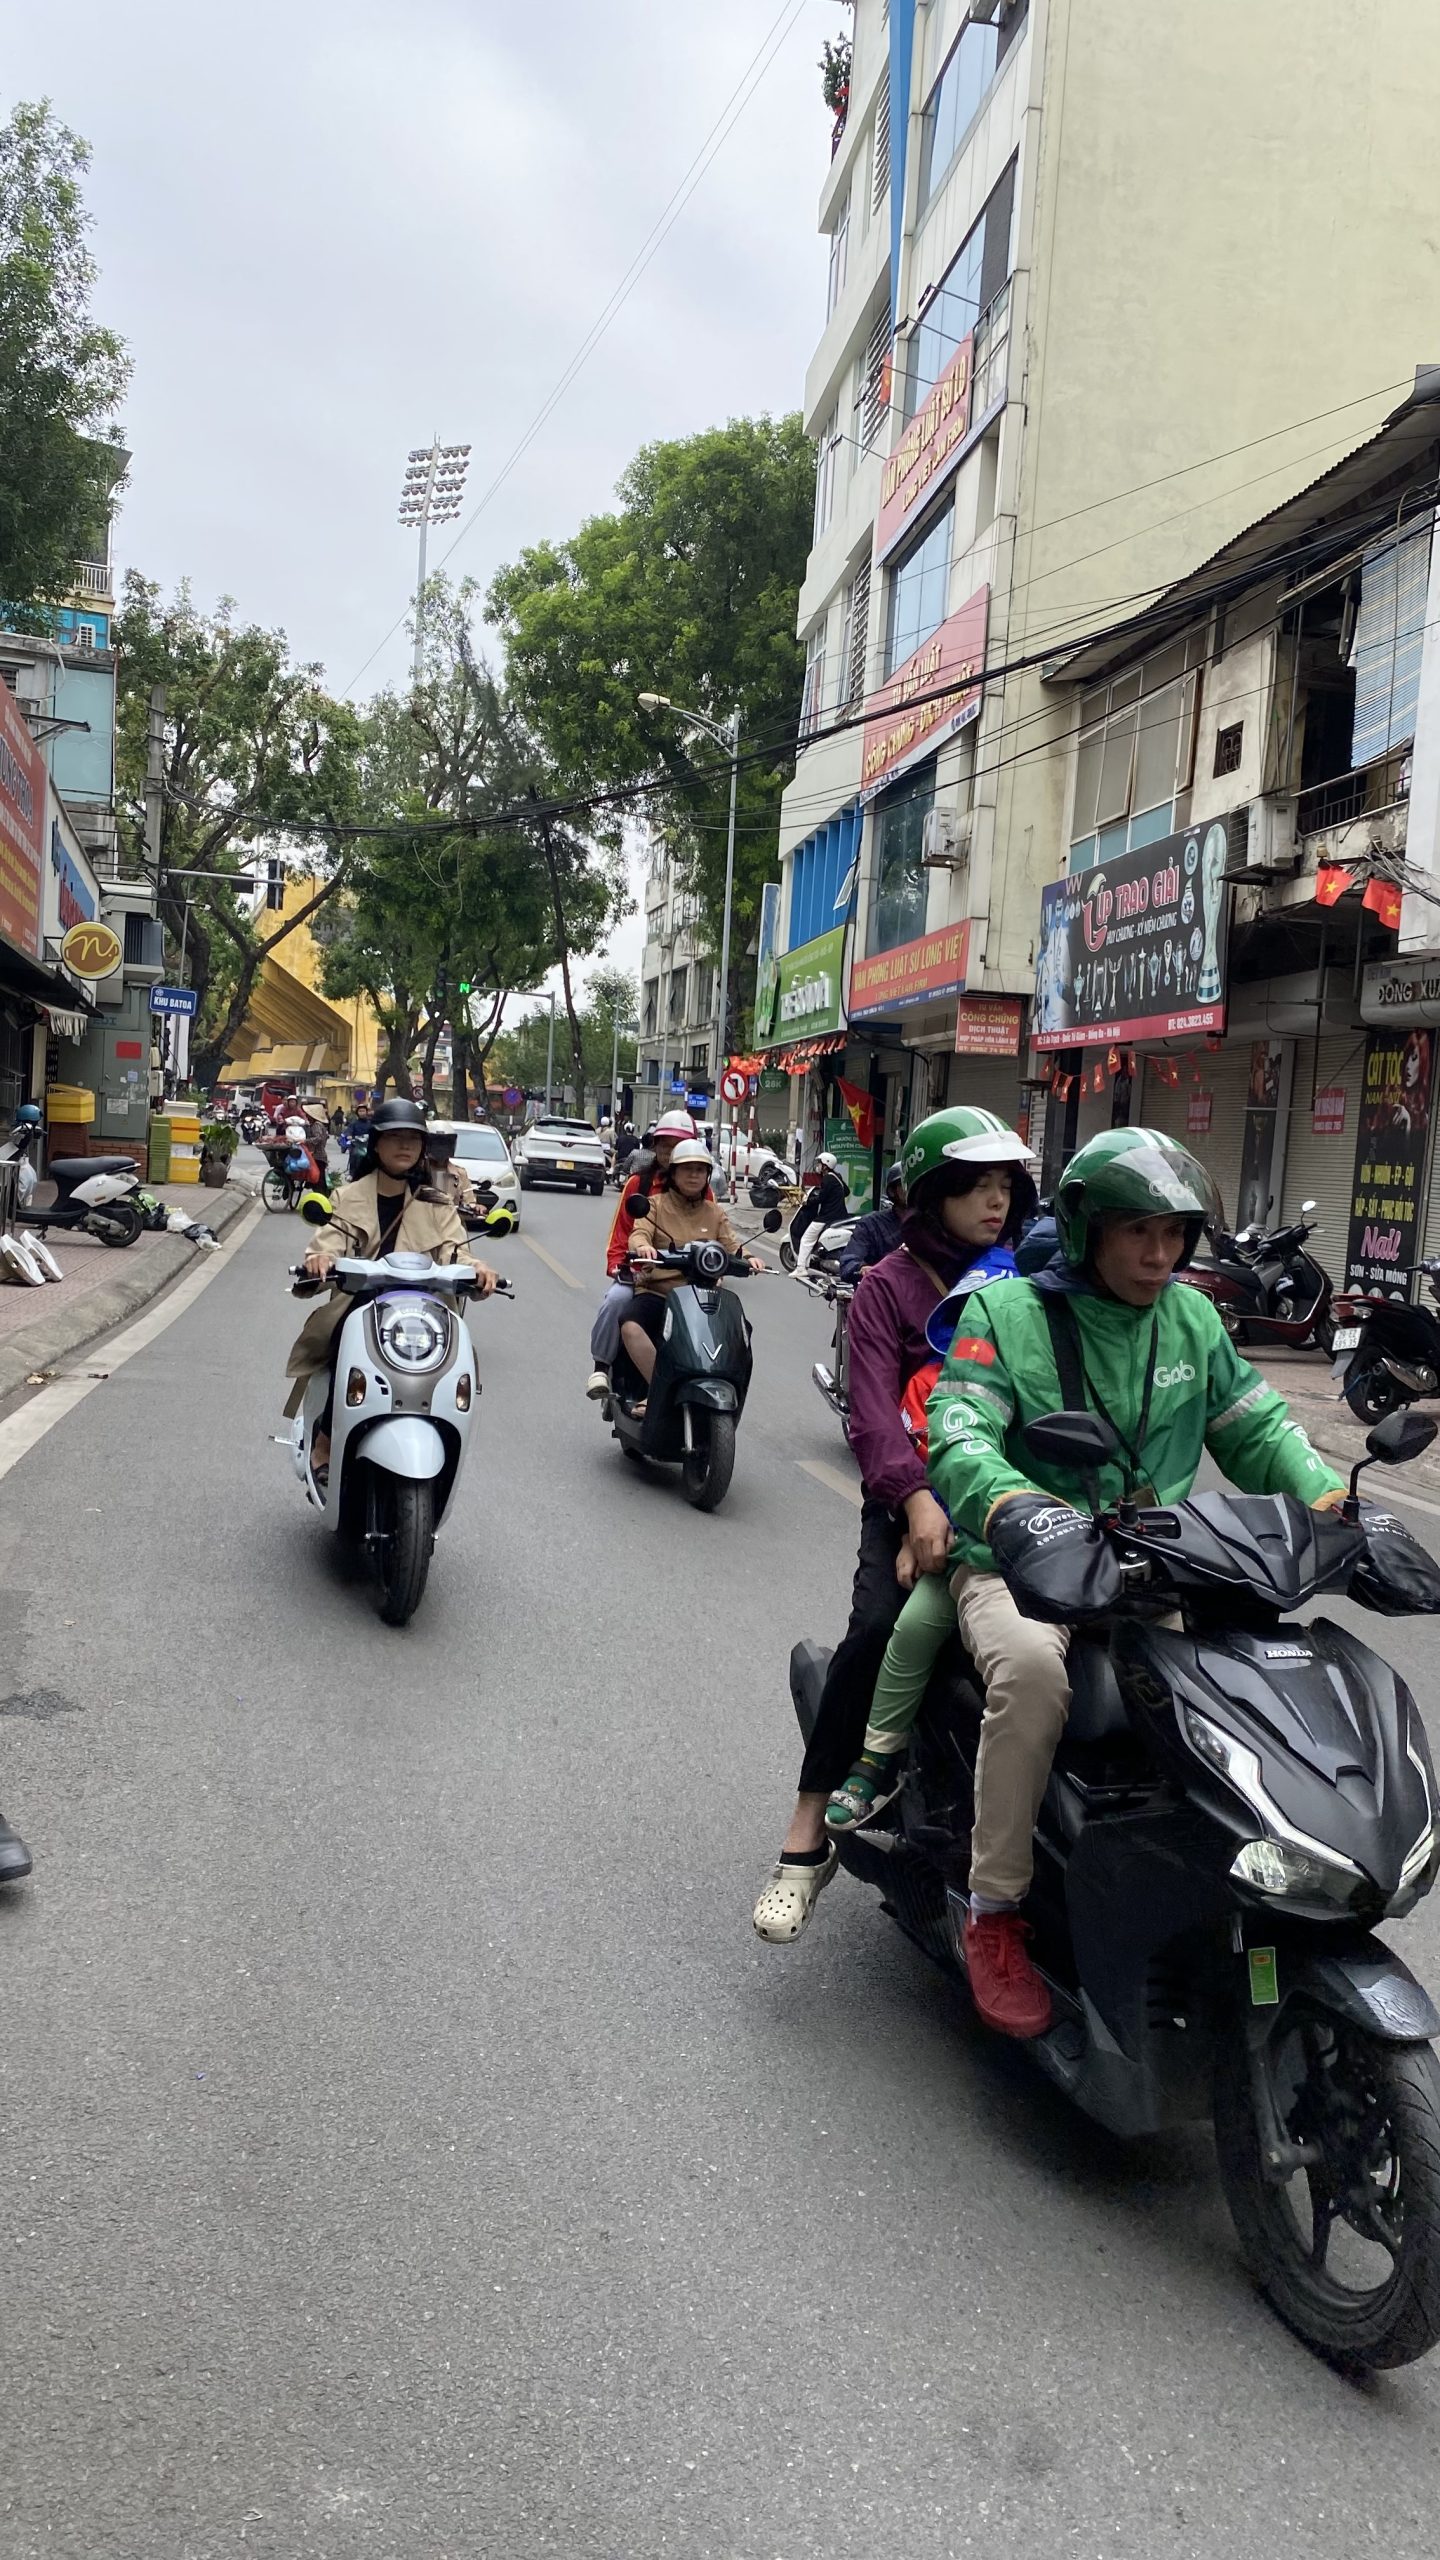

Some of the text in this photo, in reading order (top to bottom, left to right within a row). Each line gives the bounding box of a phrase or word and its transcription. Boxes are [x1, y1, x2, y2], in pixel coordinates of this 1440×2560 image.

[1115, 876, 1149, 921] TRAO
[1151, 856, 1180, 909] GIẢI
[920, 939, 943, 970] LONG
[944, 930, 964, 965] VIỆT
[154, 996, 168, 1007] KHU
[960, 1010, 987, 1023] CÔNG
[968, 1024, 986, 1035] DỊCH
[1360, 1225, 1402, 1262] Nail
[1350, 1262, 1408, 1286] SƠN SỬA MÓNG
[1265, 1649, 1313, 1660] HONDA
